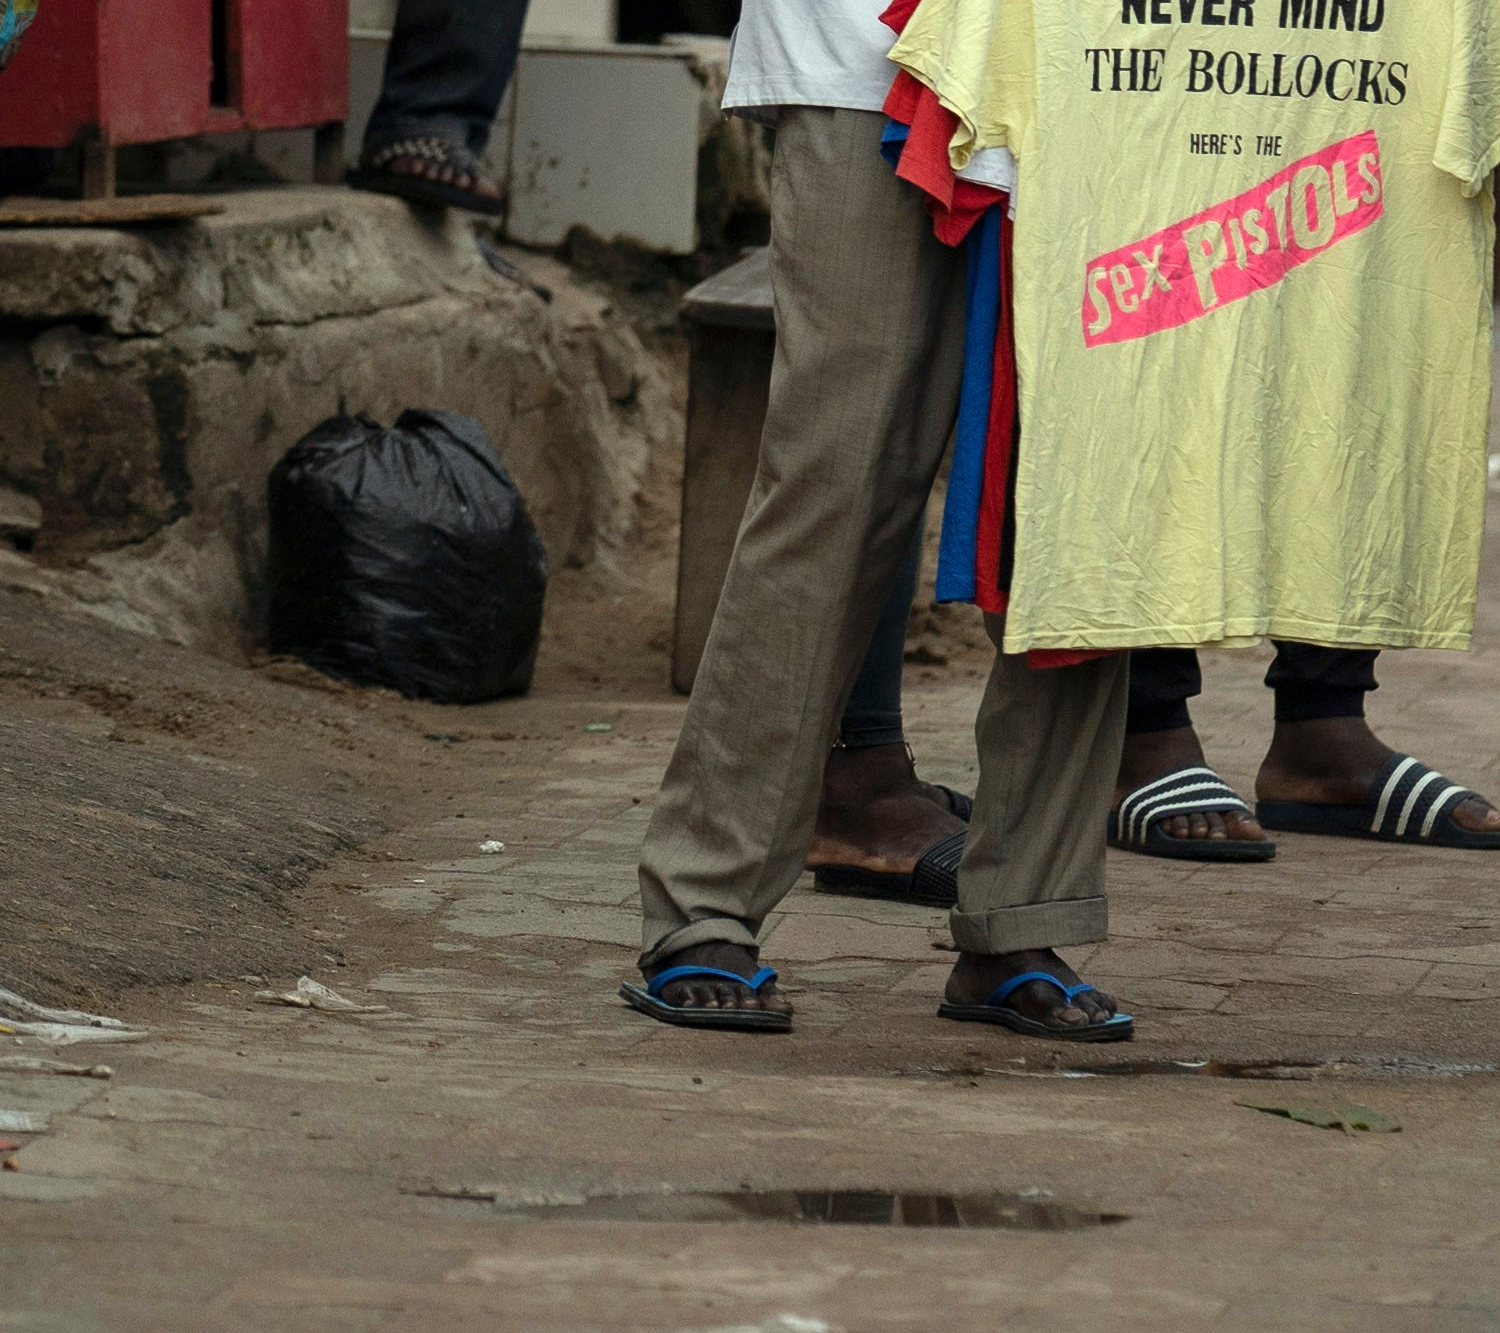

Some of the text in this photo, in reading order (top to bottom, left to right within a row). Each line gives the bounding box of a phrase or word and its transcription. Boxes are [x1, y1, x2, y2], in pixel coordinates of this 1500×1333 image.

[1085, 48, 1409, 106] THE BOLLOCKS
[1189, 133, 1282, 157] HERE'S THE
